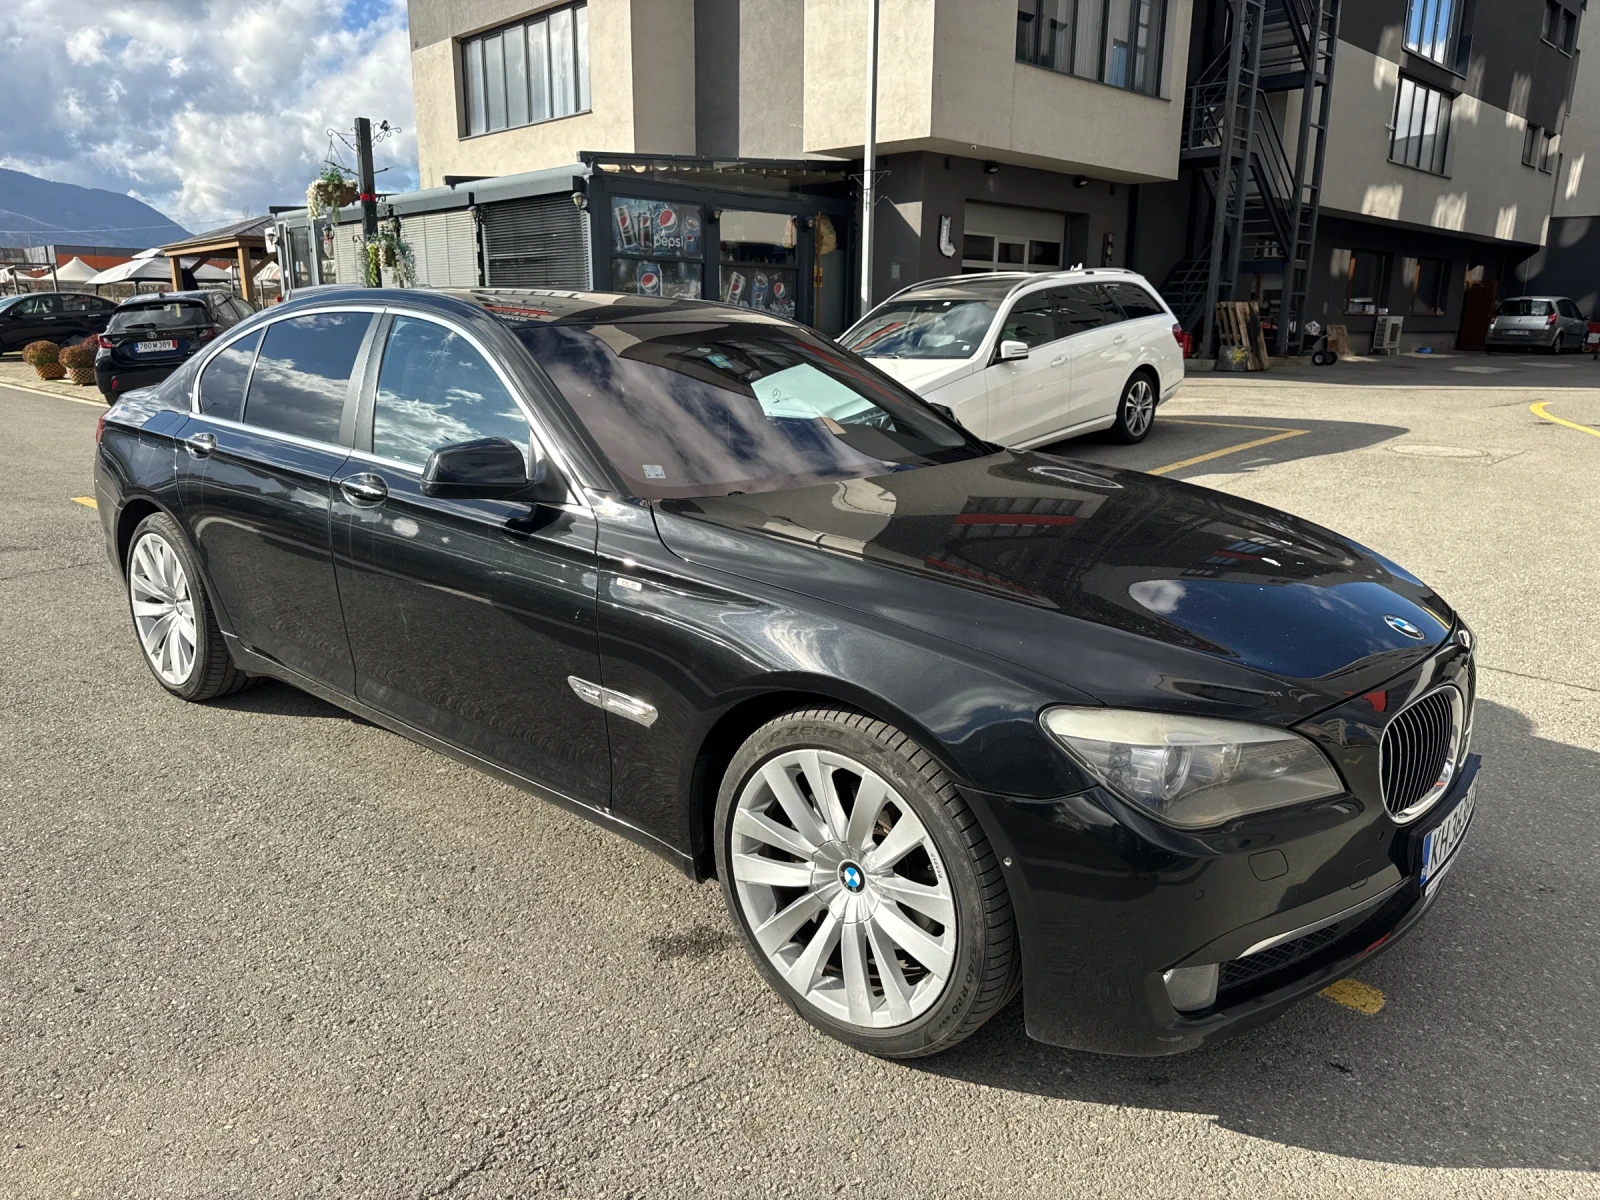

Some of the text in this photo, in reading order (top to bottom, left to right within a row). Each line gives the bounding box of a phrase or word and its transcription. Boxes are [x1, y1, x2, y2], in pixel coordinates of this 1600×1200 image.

[653, 235, 684, 249] pepsi
[785, 725, 846, 739] ZERO
[950, 985, 969, 1015] R20
